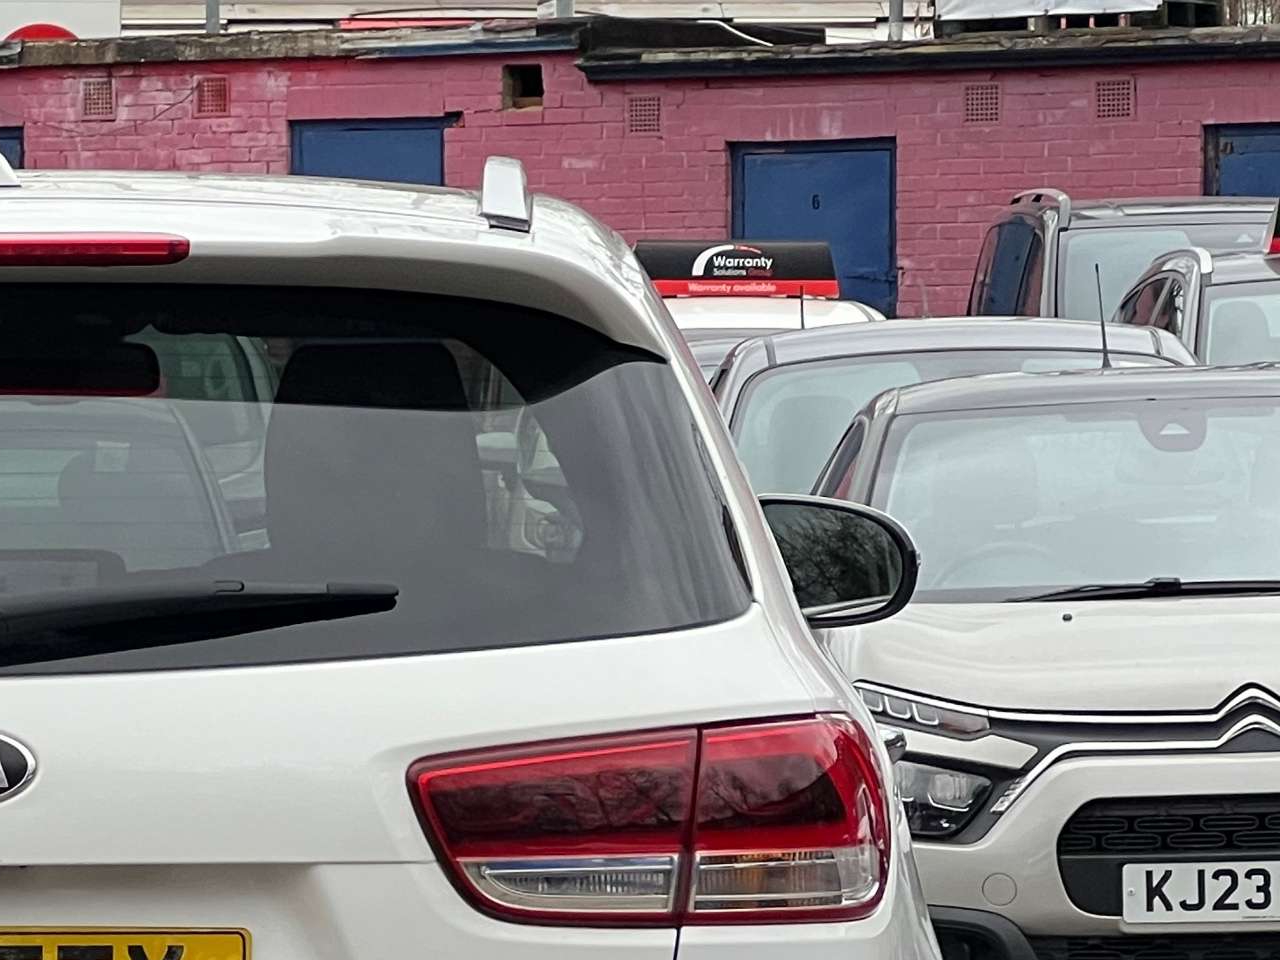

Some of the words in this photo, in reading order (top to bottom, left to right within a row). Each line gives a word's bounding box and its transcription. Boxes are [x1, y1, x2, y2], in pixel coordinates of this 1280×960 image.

[812, 194, 820, 210] 6
[713, 255, 773, 270] Warranty
[687, 283, 732, 294] Warranty
[733, 283, 777, 292] available
[1145, 868, 1272, 912] KJ23
